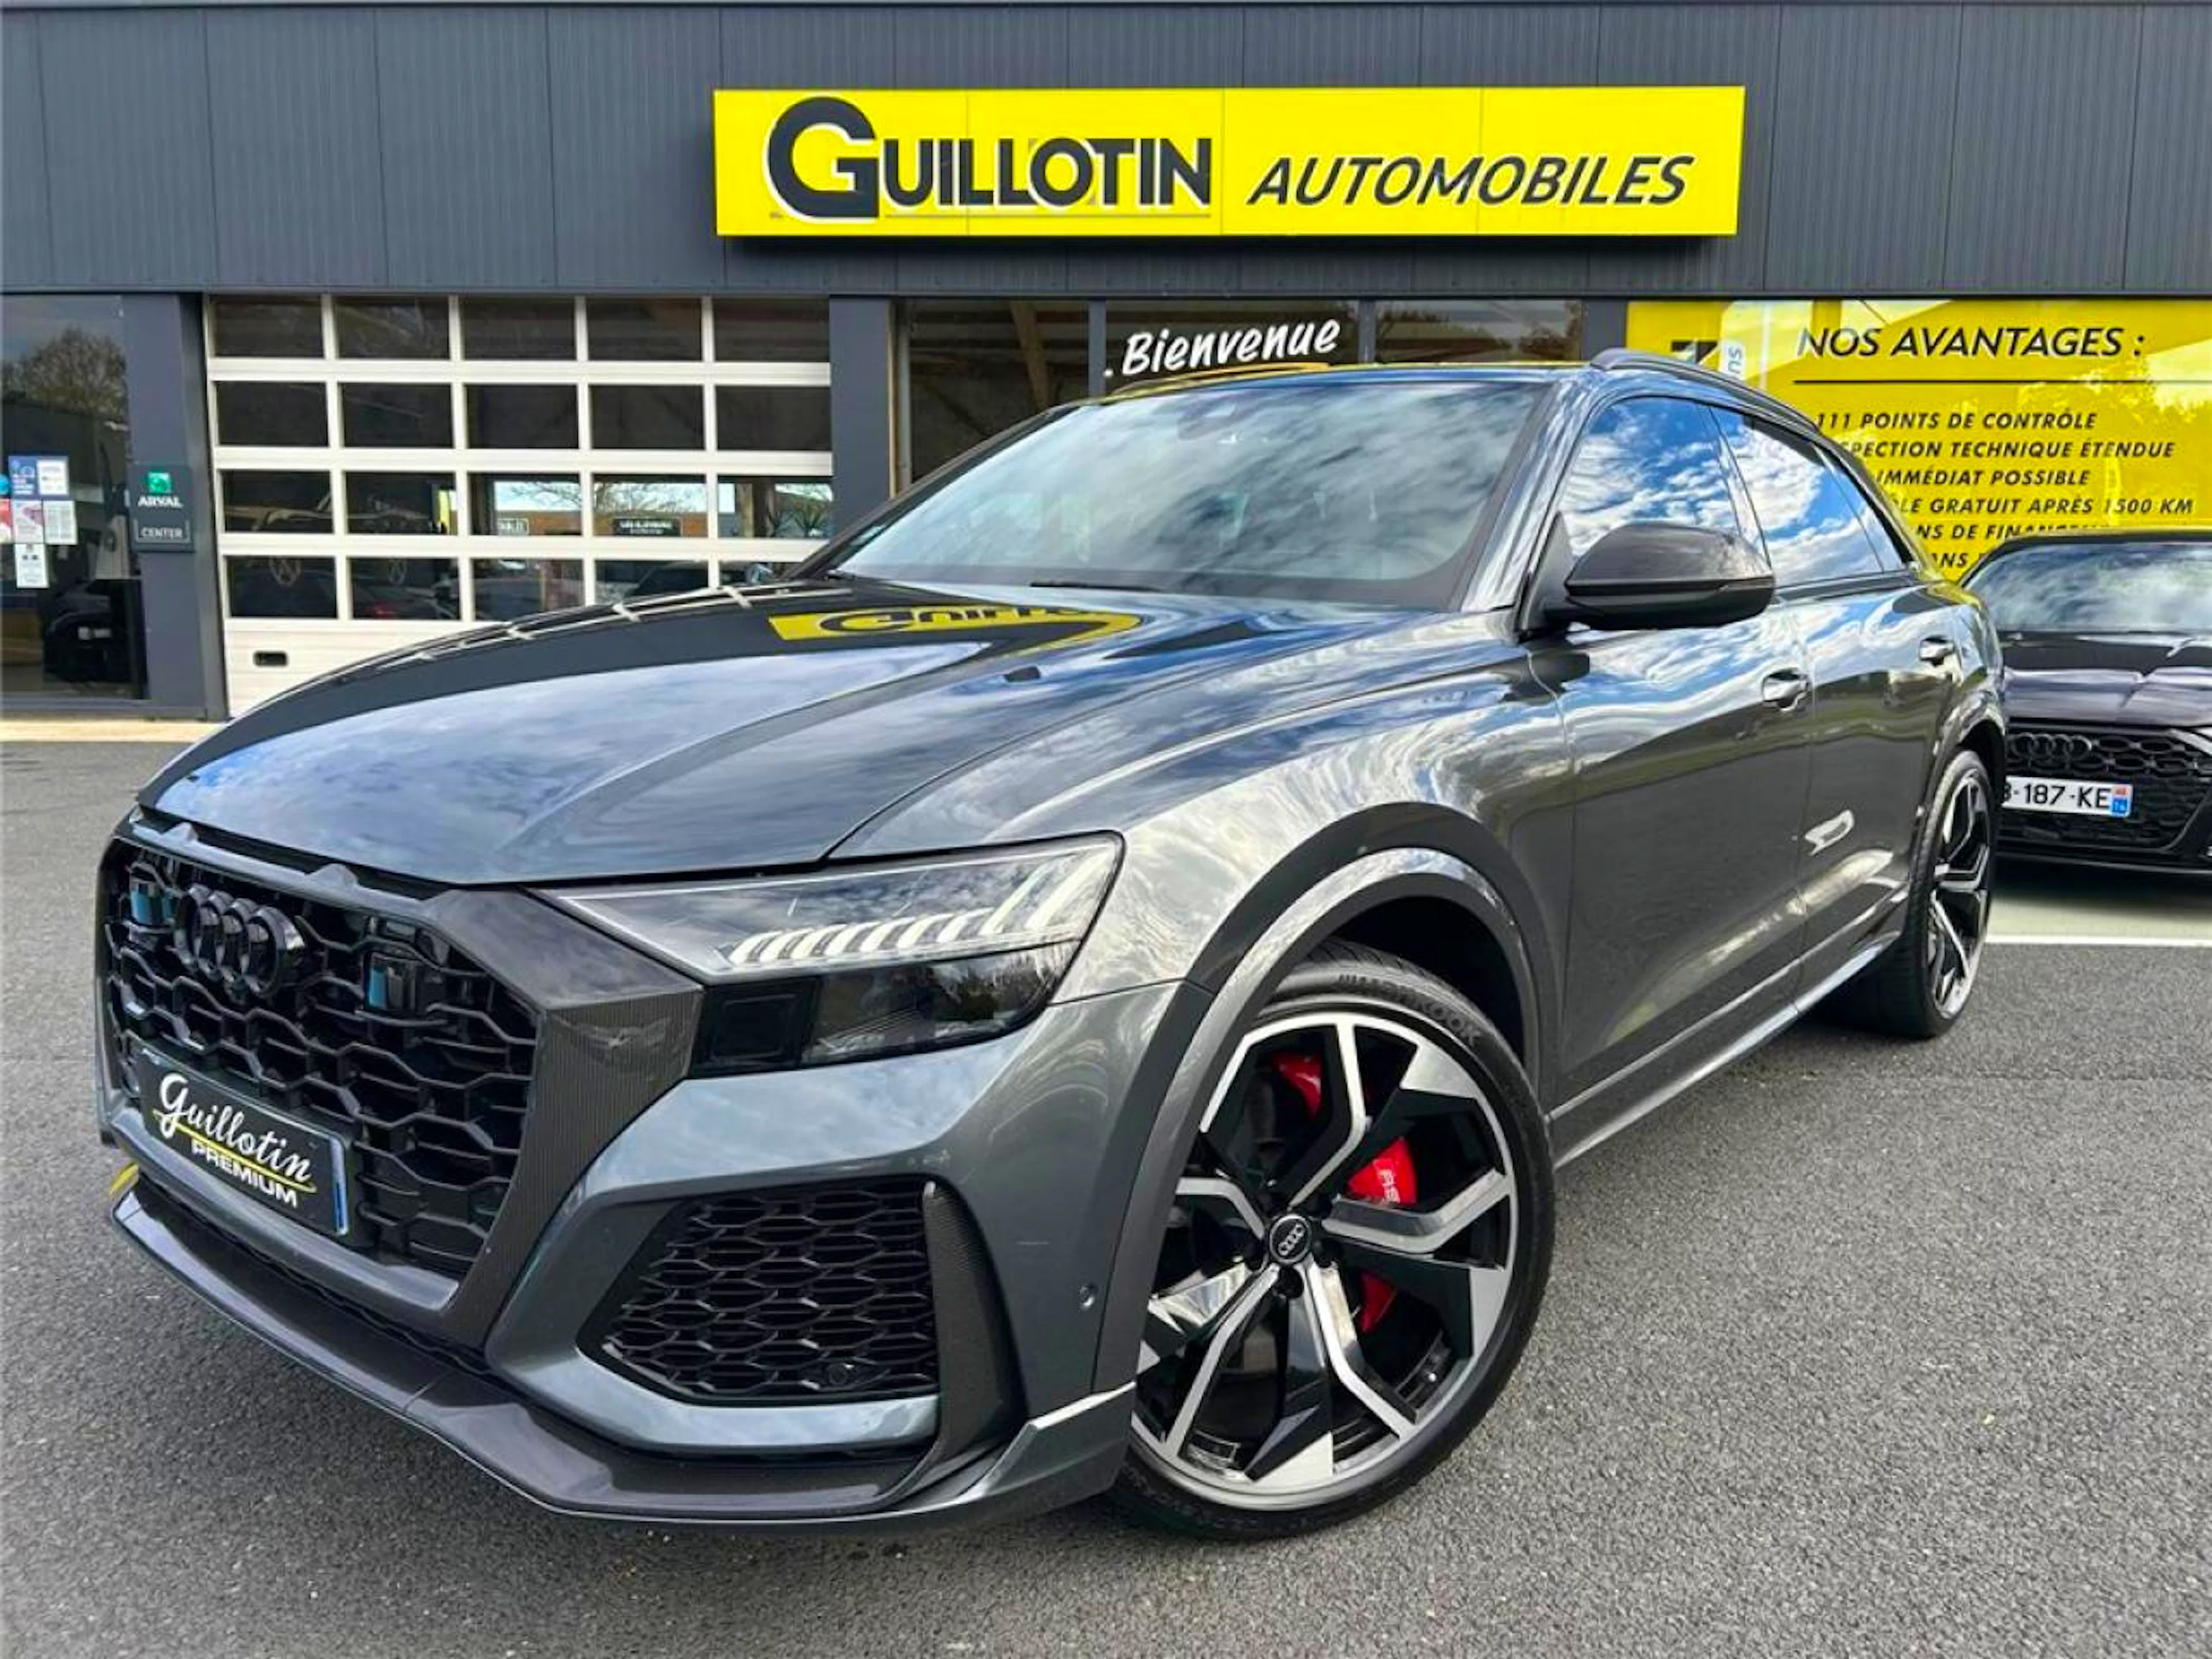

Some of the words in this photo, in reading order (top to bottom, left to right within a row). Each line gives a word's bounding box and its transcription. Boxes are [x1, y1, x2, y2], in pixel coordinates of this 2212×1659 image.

[767, 96, 1211, 219] GUILLOTIN
[1246, 156, 1695, 206] AUTOMOBILES
[1122, 319, 1340, 377] Bienvenue
[1798, 328, 1882, 357] NOS
[1890, 327, 2124, 357] AVANTAGES
[1818, 412, 1850, 429] 111
[1860, 412, 1940, 429] POINTS
[1948, 412, 1974, 428] DE
[1982, 406, 2097, 429] CONTRÔLE
[1950, 442, 2073, 458] TECHNIQUE
[2080, 437, 2175, 457] ÉTENDUE
[1990, 470, 2090, 485] POSSIBLE
[1930, 498, 2021, 513] GRATUIT
[2028, 493, 2094, 513] APRÈS
[2104, 499, 2152, 513] 1500
[2160, 499, 2194, 513] KM
[140, 527, 183, 539] CENTER
[1951, 525, 1978, 539] DE
[190, 1137, 298, 1209] PREMIUM
